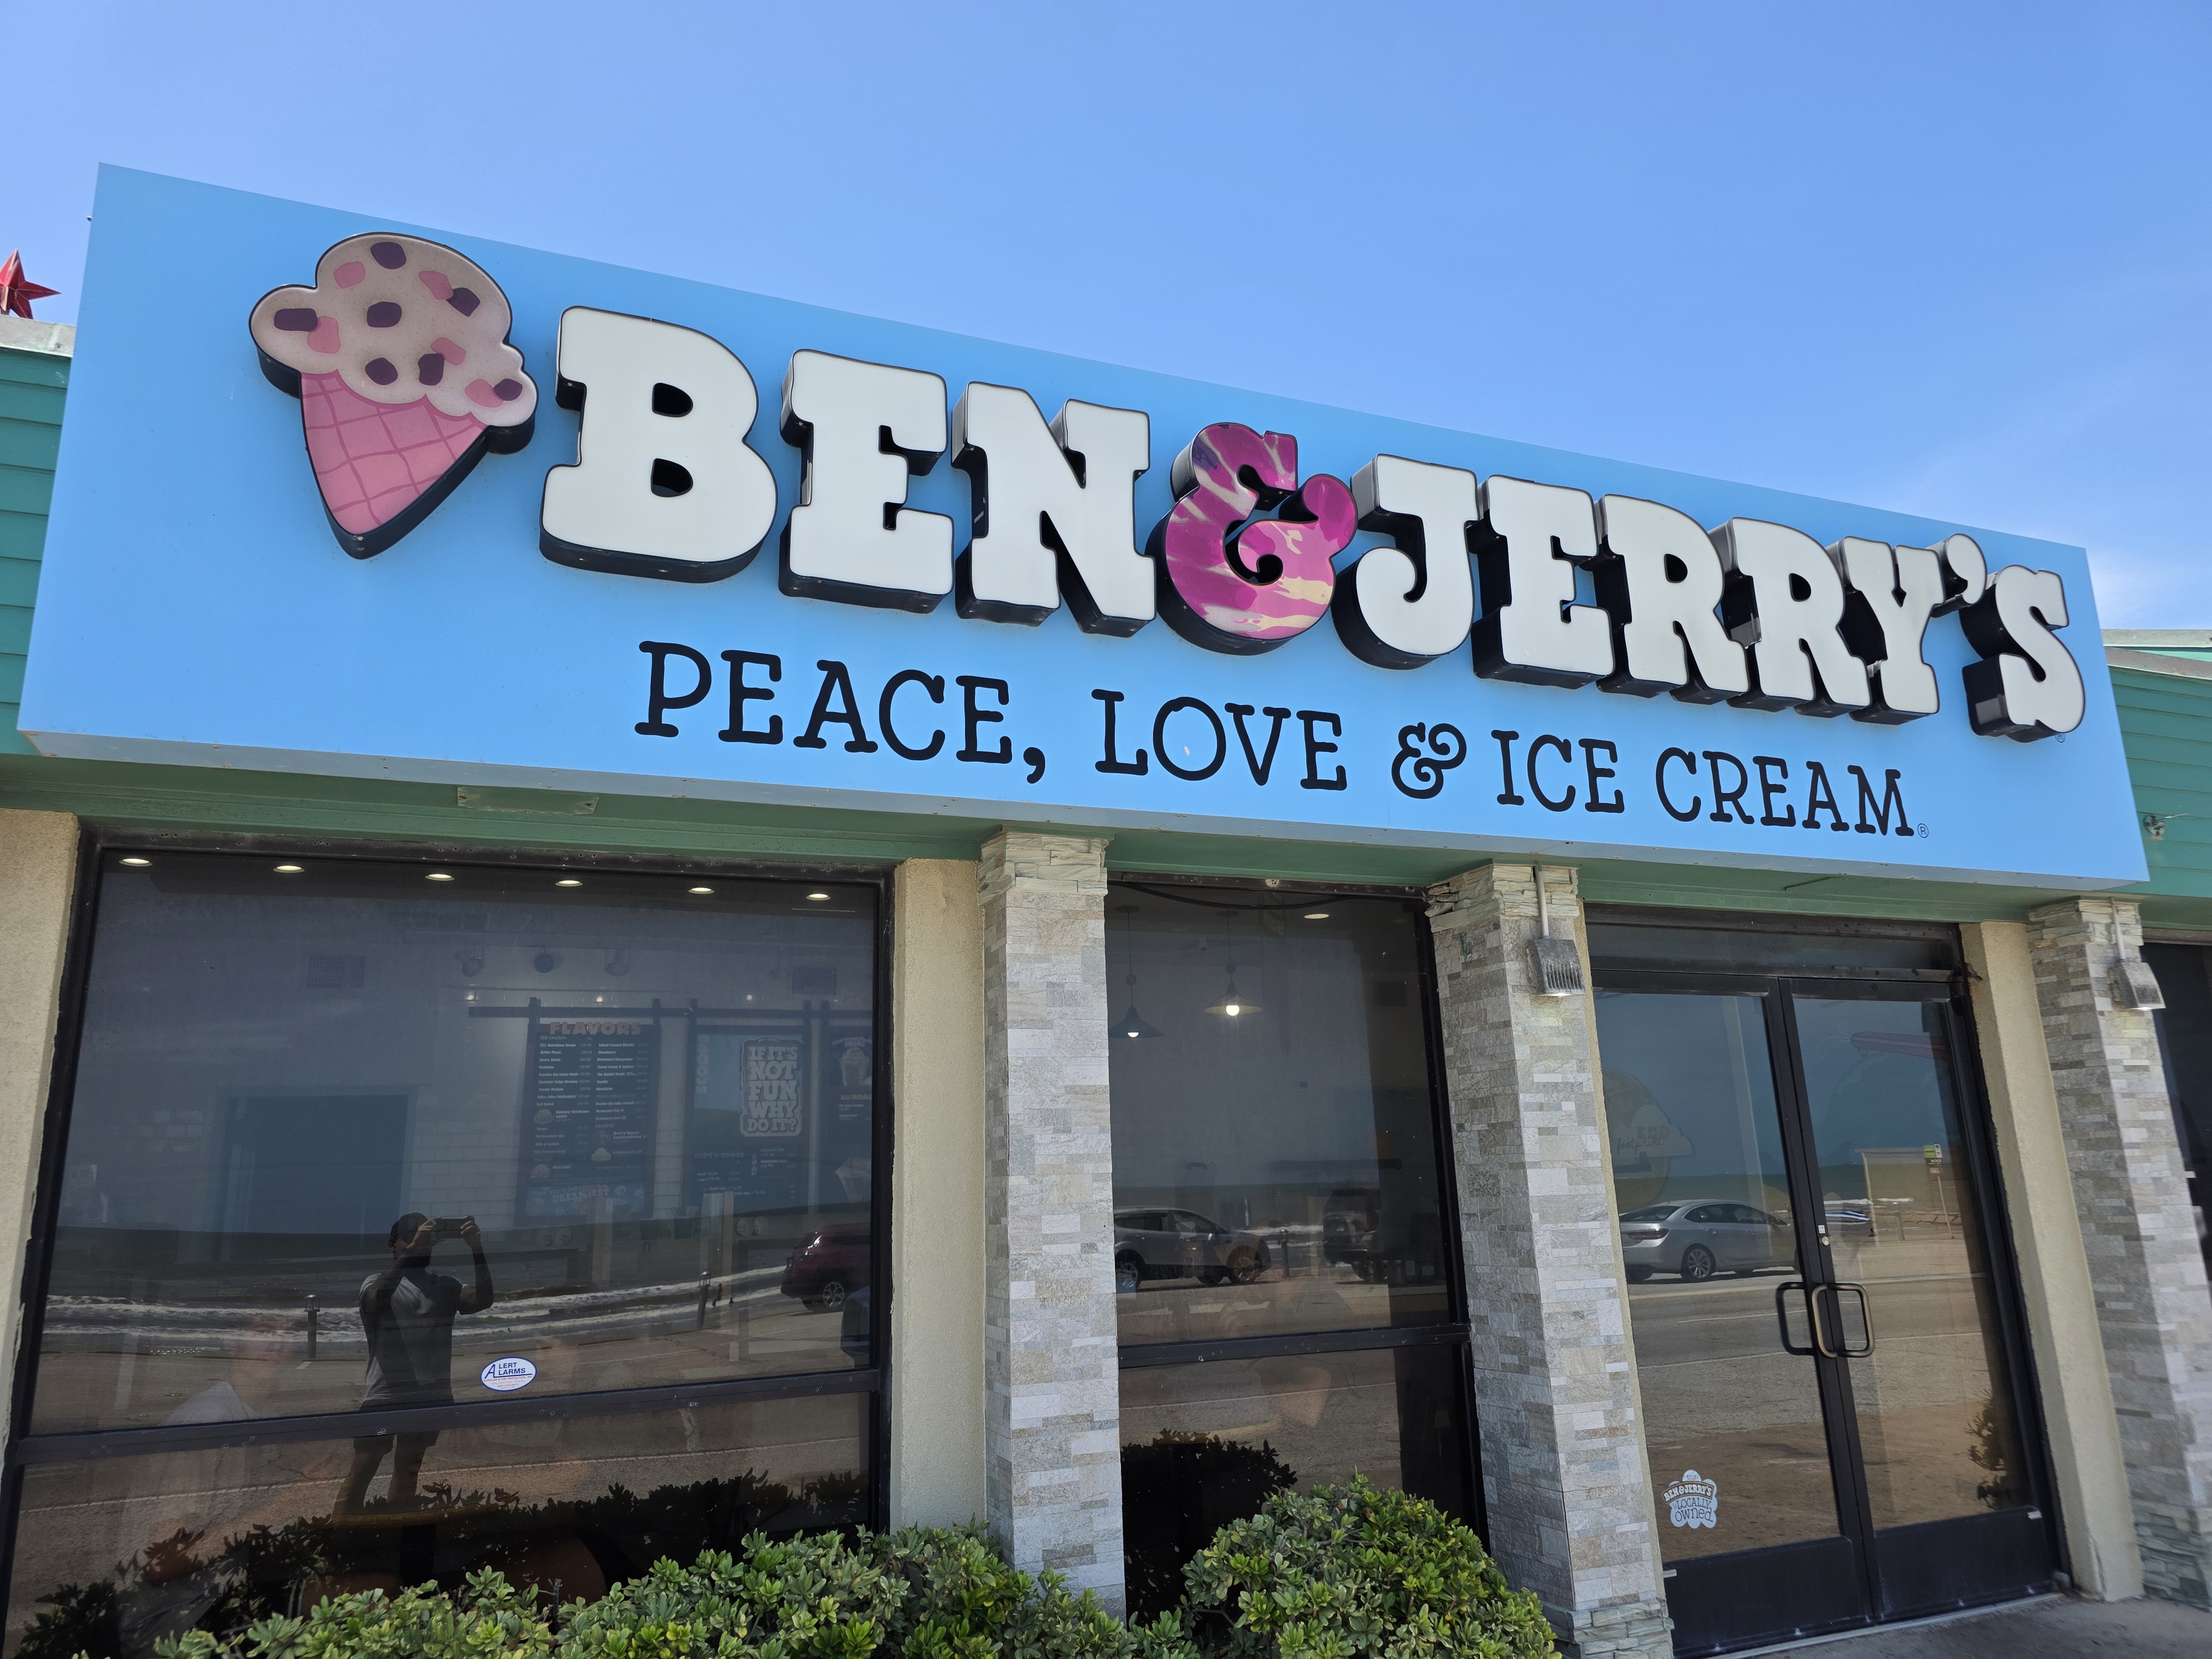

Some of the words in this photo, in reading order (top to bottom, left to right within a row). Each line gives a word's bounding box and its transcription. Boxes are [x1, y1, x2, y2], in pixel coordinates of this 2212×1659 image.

[634, 640, 1046, 784] PEACE,
[1091, 689, 1348, 791] LOVE
[1391, 722, 1467, 800] &
[1491, 729, 1625, 813] ICE
[550, 1022, 641, 1035] FLAVORS
[749, 1046, 767, 1061] IF
[768, 1046, 798, 1061] IT'S
[749, 1060, 797, 1080] NOT
[748, 1080, 797, 1101] FUN
[748, 1100, 798, 1118] WHY
[747, 1118, 769, 1132] DO
[770, 1118, 797, 1132] IT?
[1616, 1138, 1665, 1155] footprint
[1676, 1497, 1712, 1510] LOCALLY
[1674, 1507, 1714, 1523] owned.
